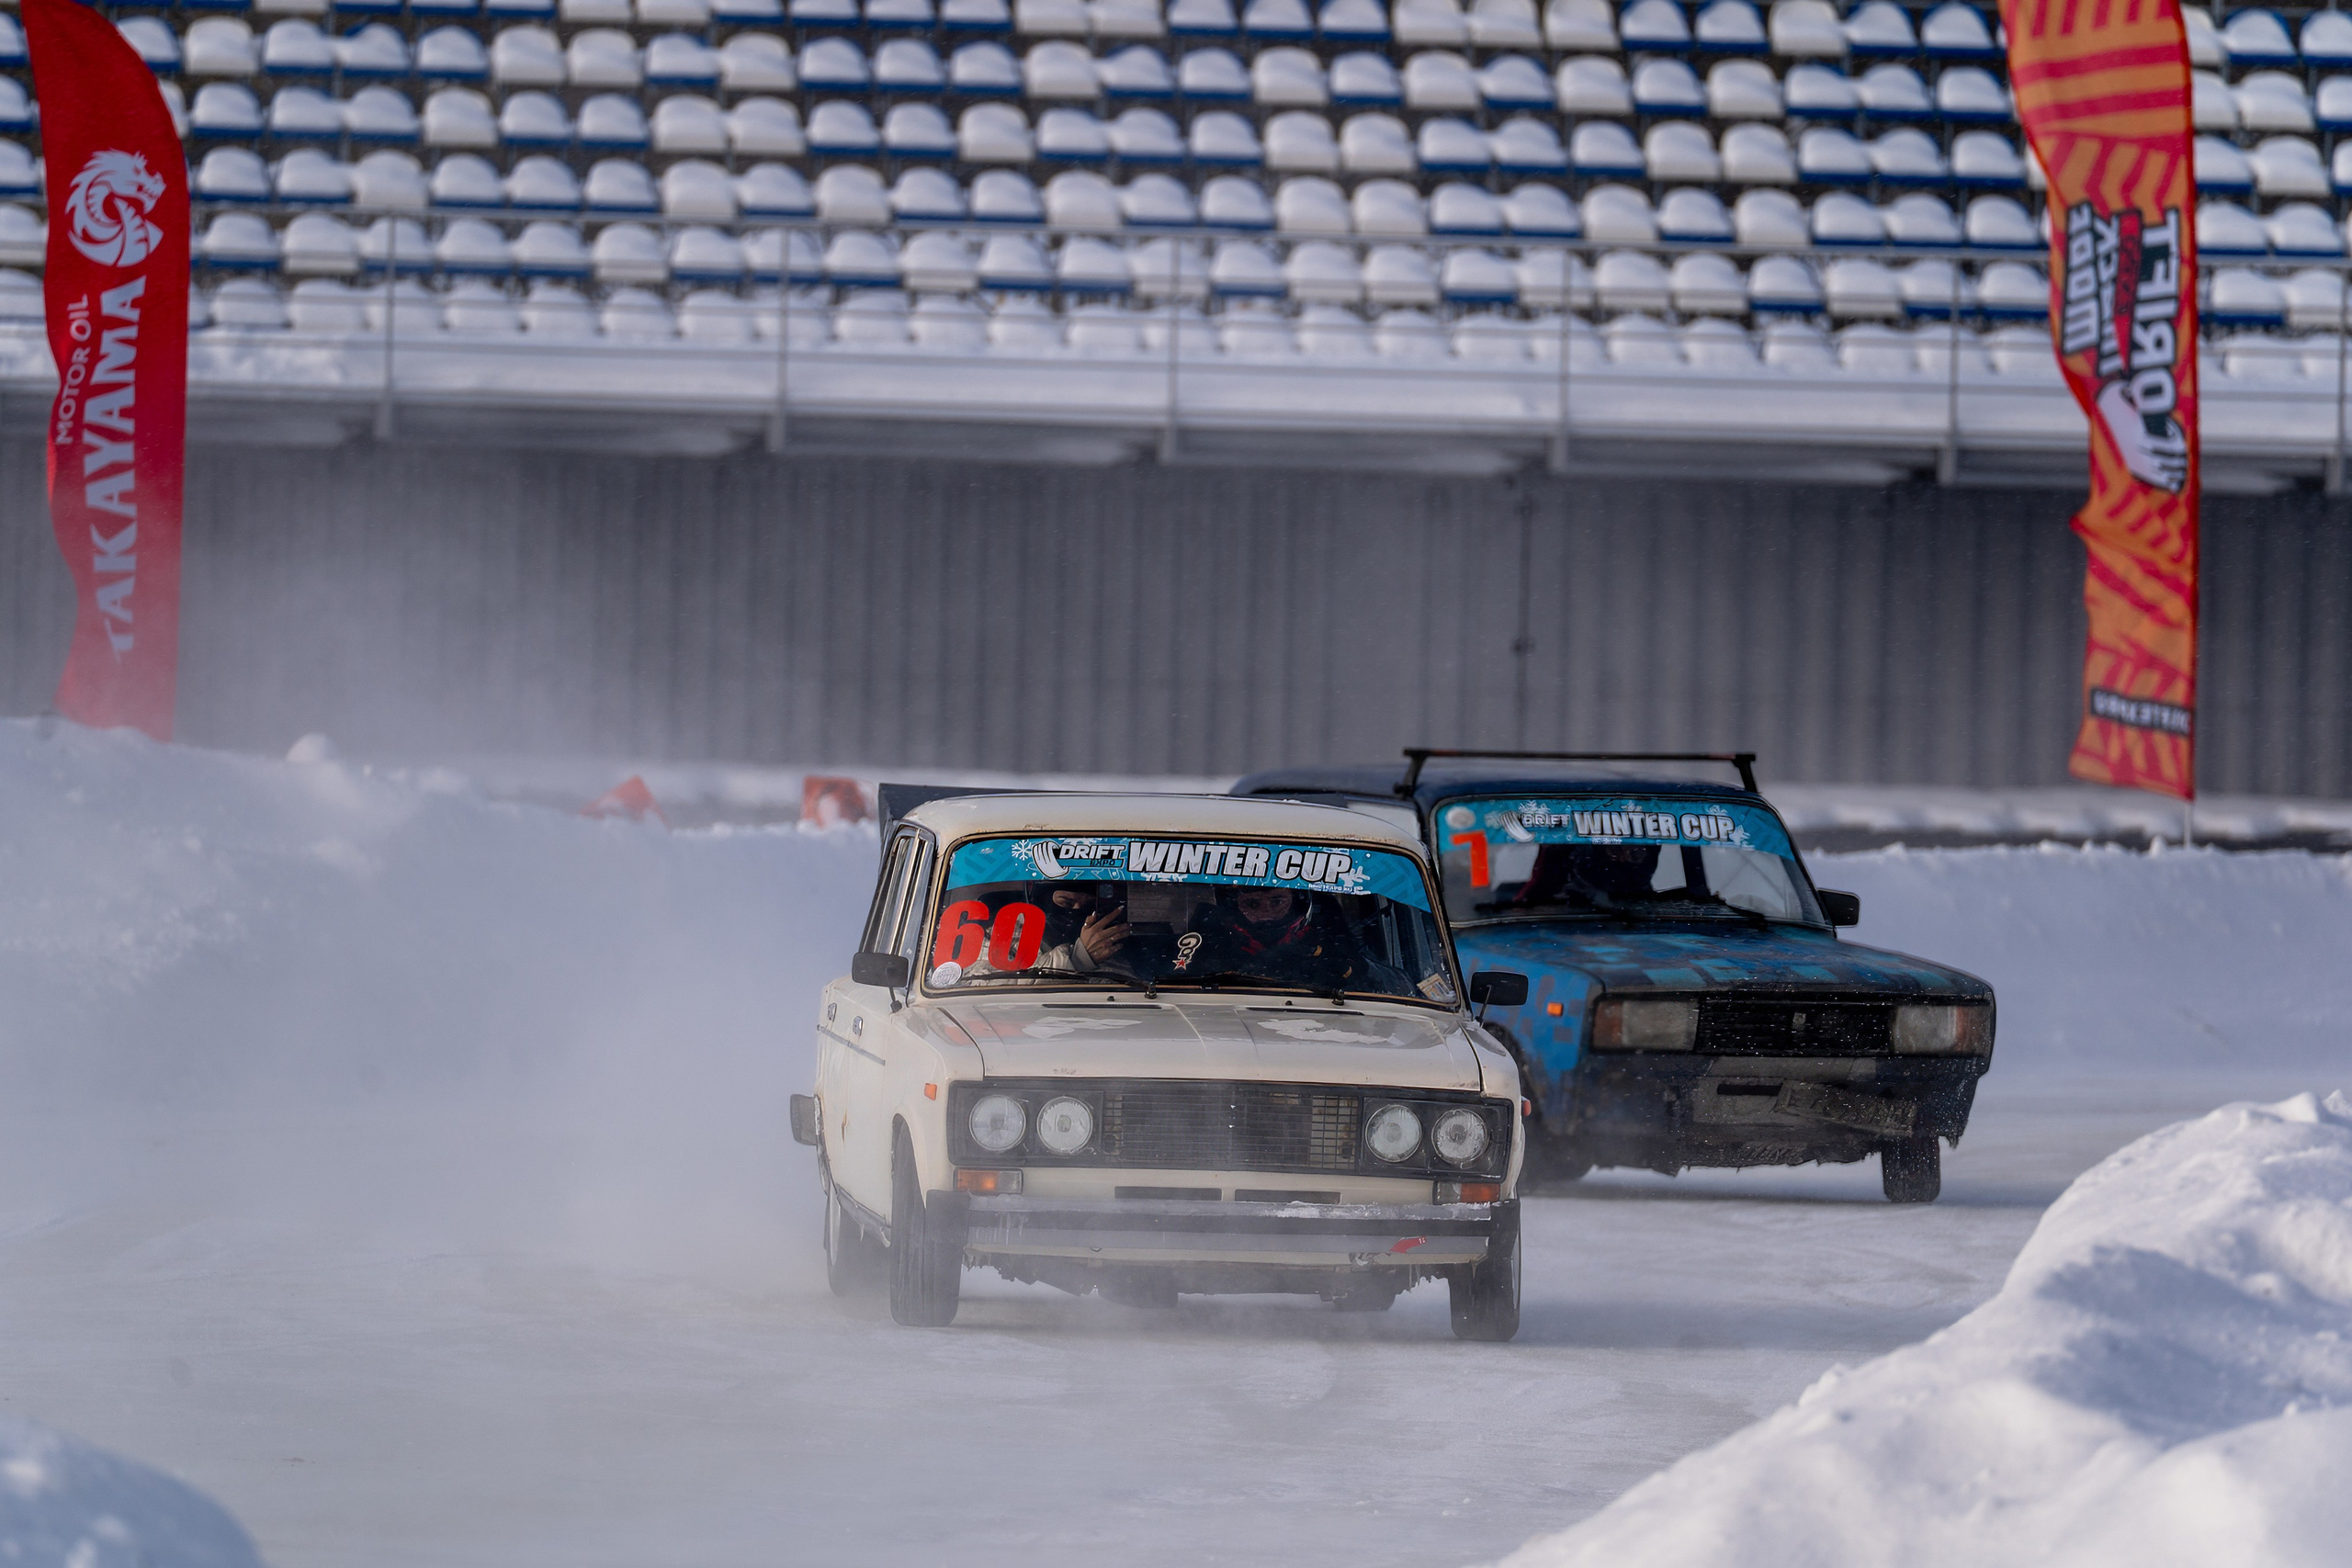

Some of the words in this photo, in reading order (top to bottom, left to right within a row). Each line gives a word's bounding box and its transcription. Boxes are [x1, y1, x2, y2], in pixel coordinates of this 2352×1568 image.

[66, 294, 93, 343] OIL
[55, 345, 91, 446] MOTOR
[83, 276, 147, 665] TAKAYAMA
[1572, 811, 1679, 839] WINTER
[1681, 815, 1735, 840] CUP
[1059, 844, 1125, 859] DRIFT
[1128, 841, 1268, 878] WINTER
[1274, 847, 1351, 884] CUP
[933, 899, 1046, 971] 60
